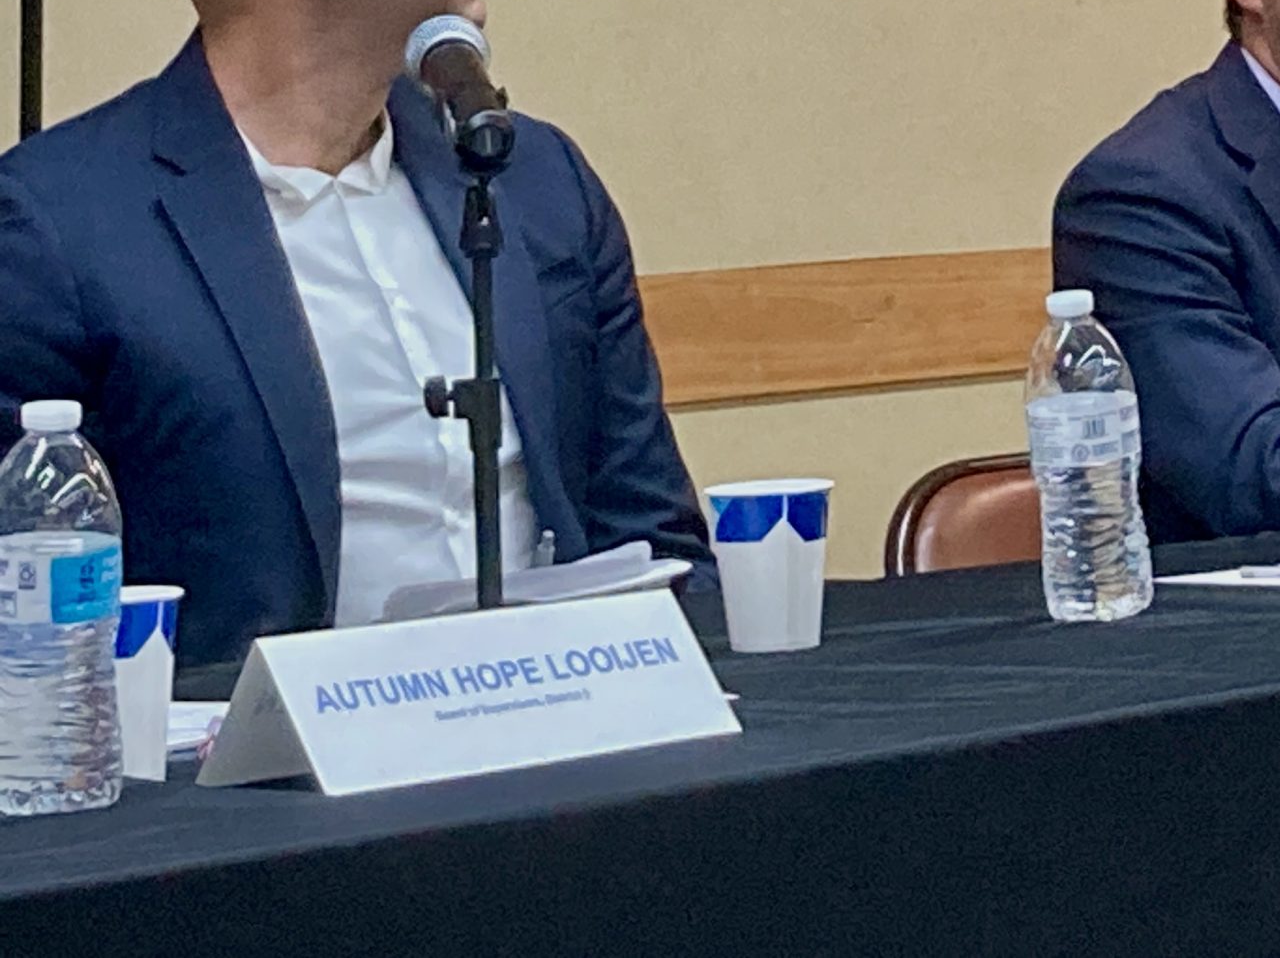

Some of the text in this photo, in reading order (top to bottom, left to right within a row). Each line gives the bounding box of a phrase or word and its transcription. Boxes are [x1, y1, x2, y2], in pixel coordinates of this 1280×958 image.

[315, 669, 450, 714] AUTUMN
[456, 656, 544, 695] HOPE
[545, 637, 680, 680] LOOIJEN
